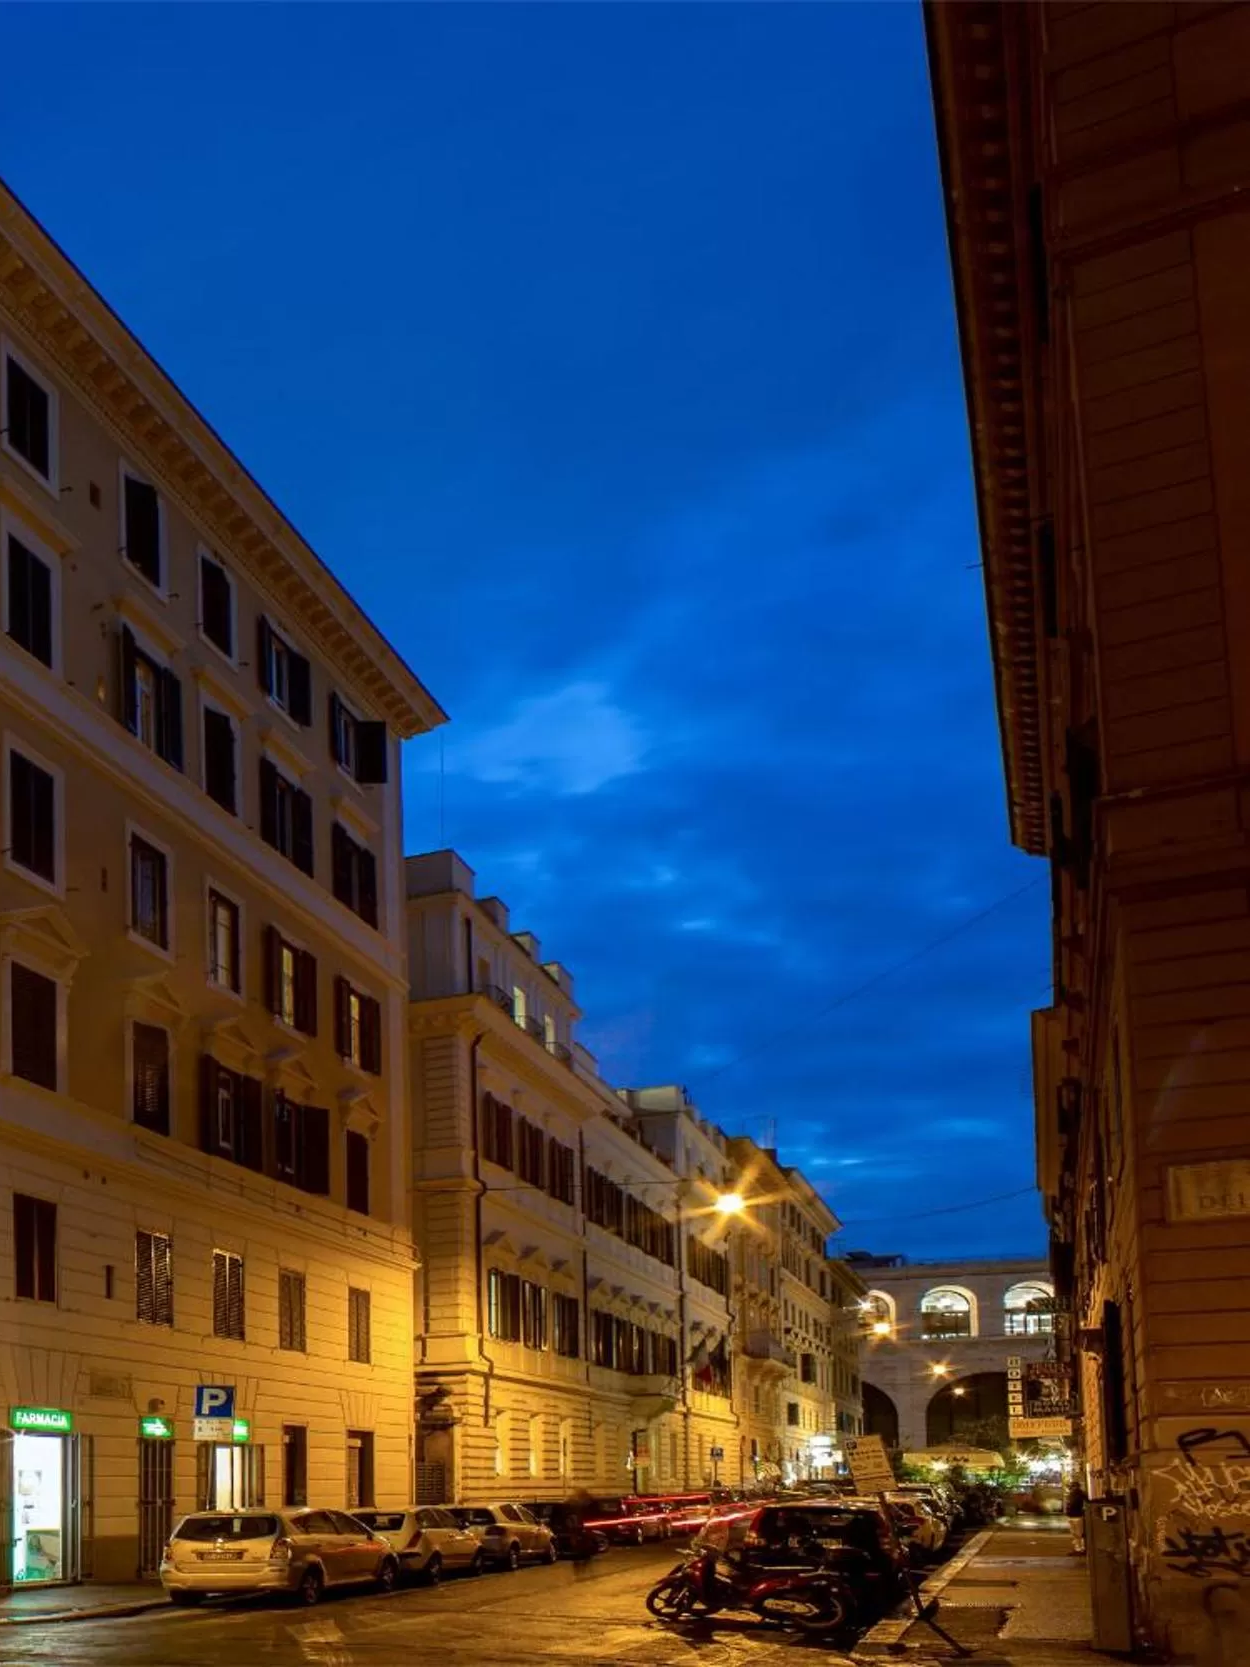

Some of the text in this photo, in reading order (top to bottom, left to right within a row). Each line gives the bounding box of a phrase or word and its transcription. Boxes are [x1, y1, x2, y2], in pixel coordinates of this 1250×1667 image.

[201, 1388, 227, 1415] P
[15, 1411, 67, 1429] FARMACIA
[1102, 1506, 1117, 1521] P
